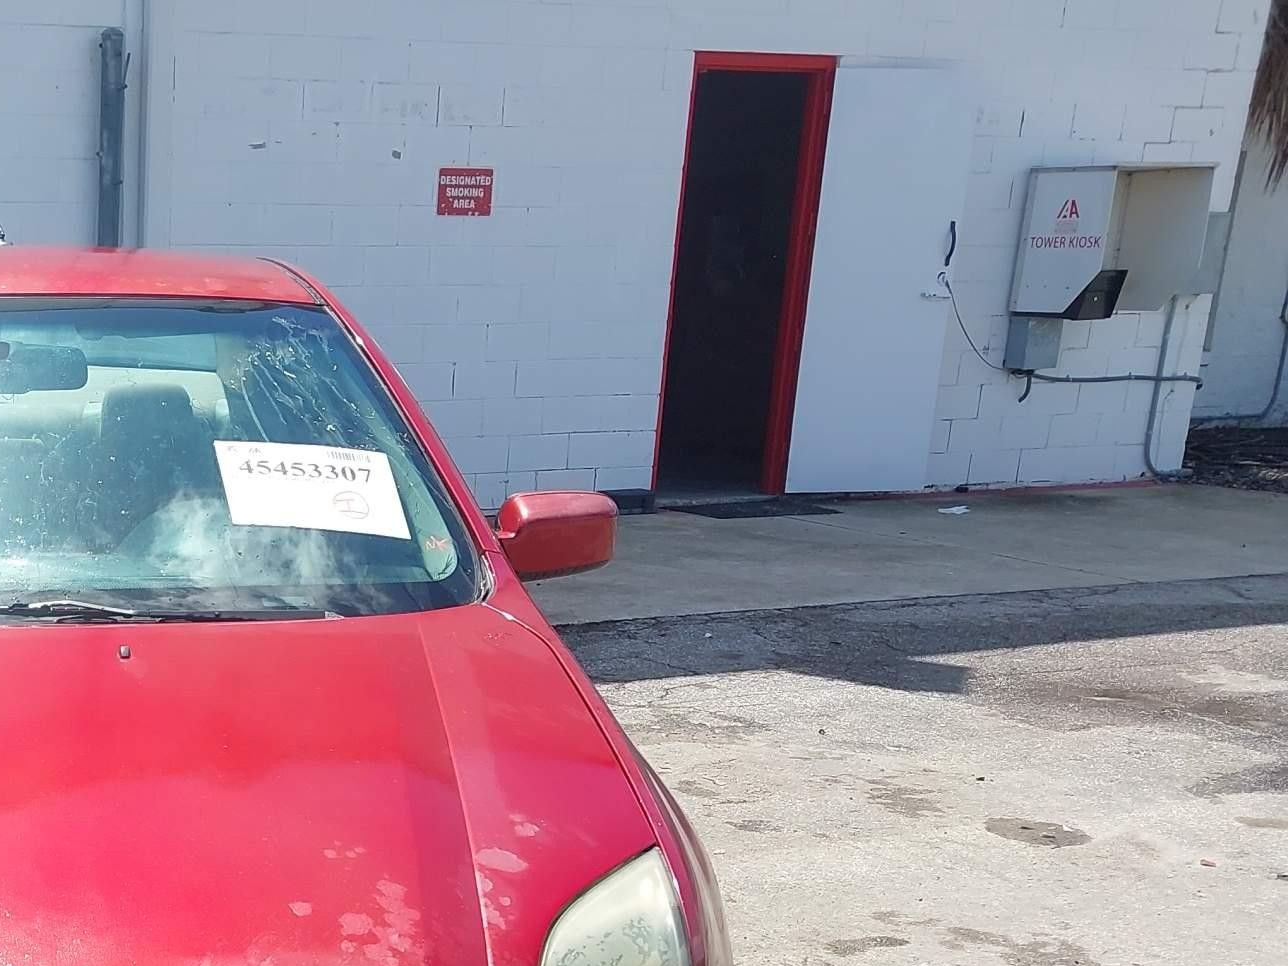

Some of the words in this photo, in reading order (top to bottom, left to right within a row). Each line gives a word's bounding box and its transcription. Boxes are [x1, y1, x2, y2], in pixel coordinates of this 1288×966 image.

[440, 175, 491, 185] DESIGNATED
[446, 187, 484, 198] SMOKING
[453, 199, 475, 209] AREA
[1030, 236, 1066, 248] TOWER
[1068, 236, 1100, 248] KIOSK
[239, 459, 371, 483] 45453307
